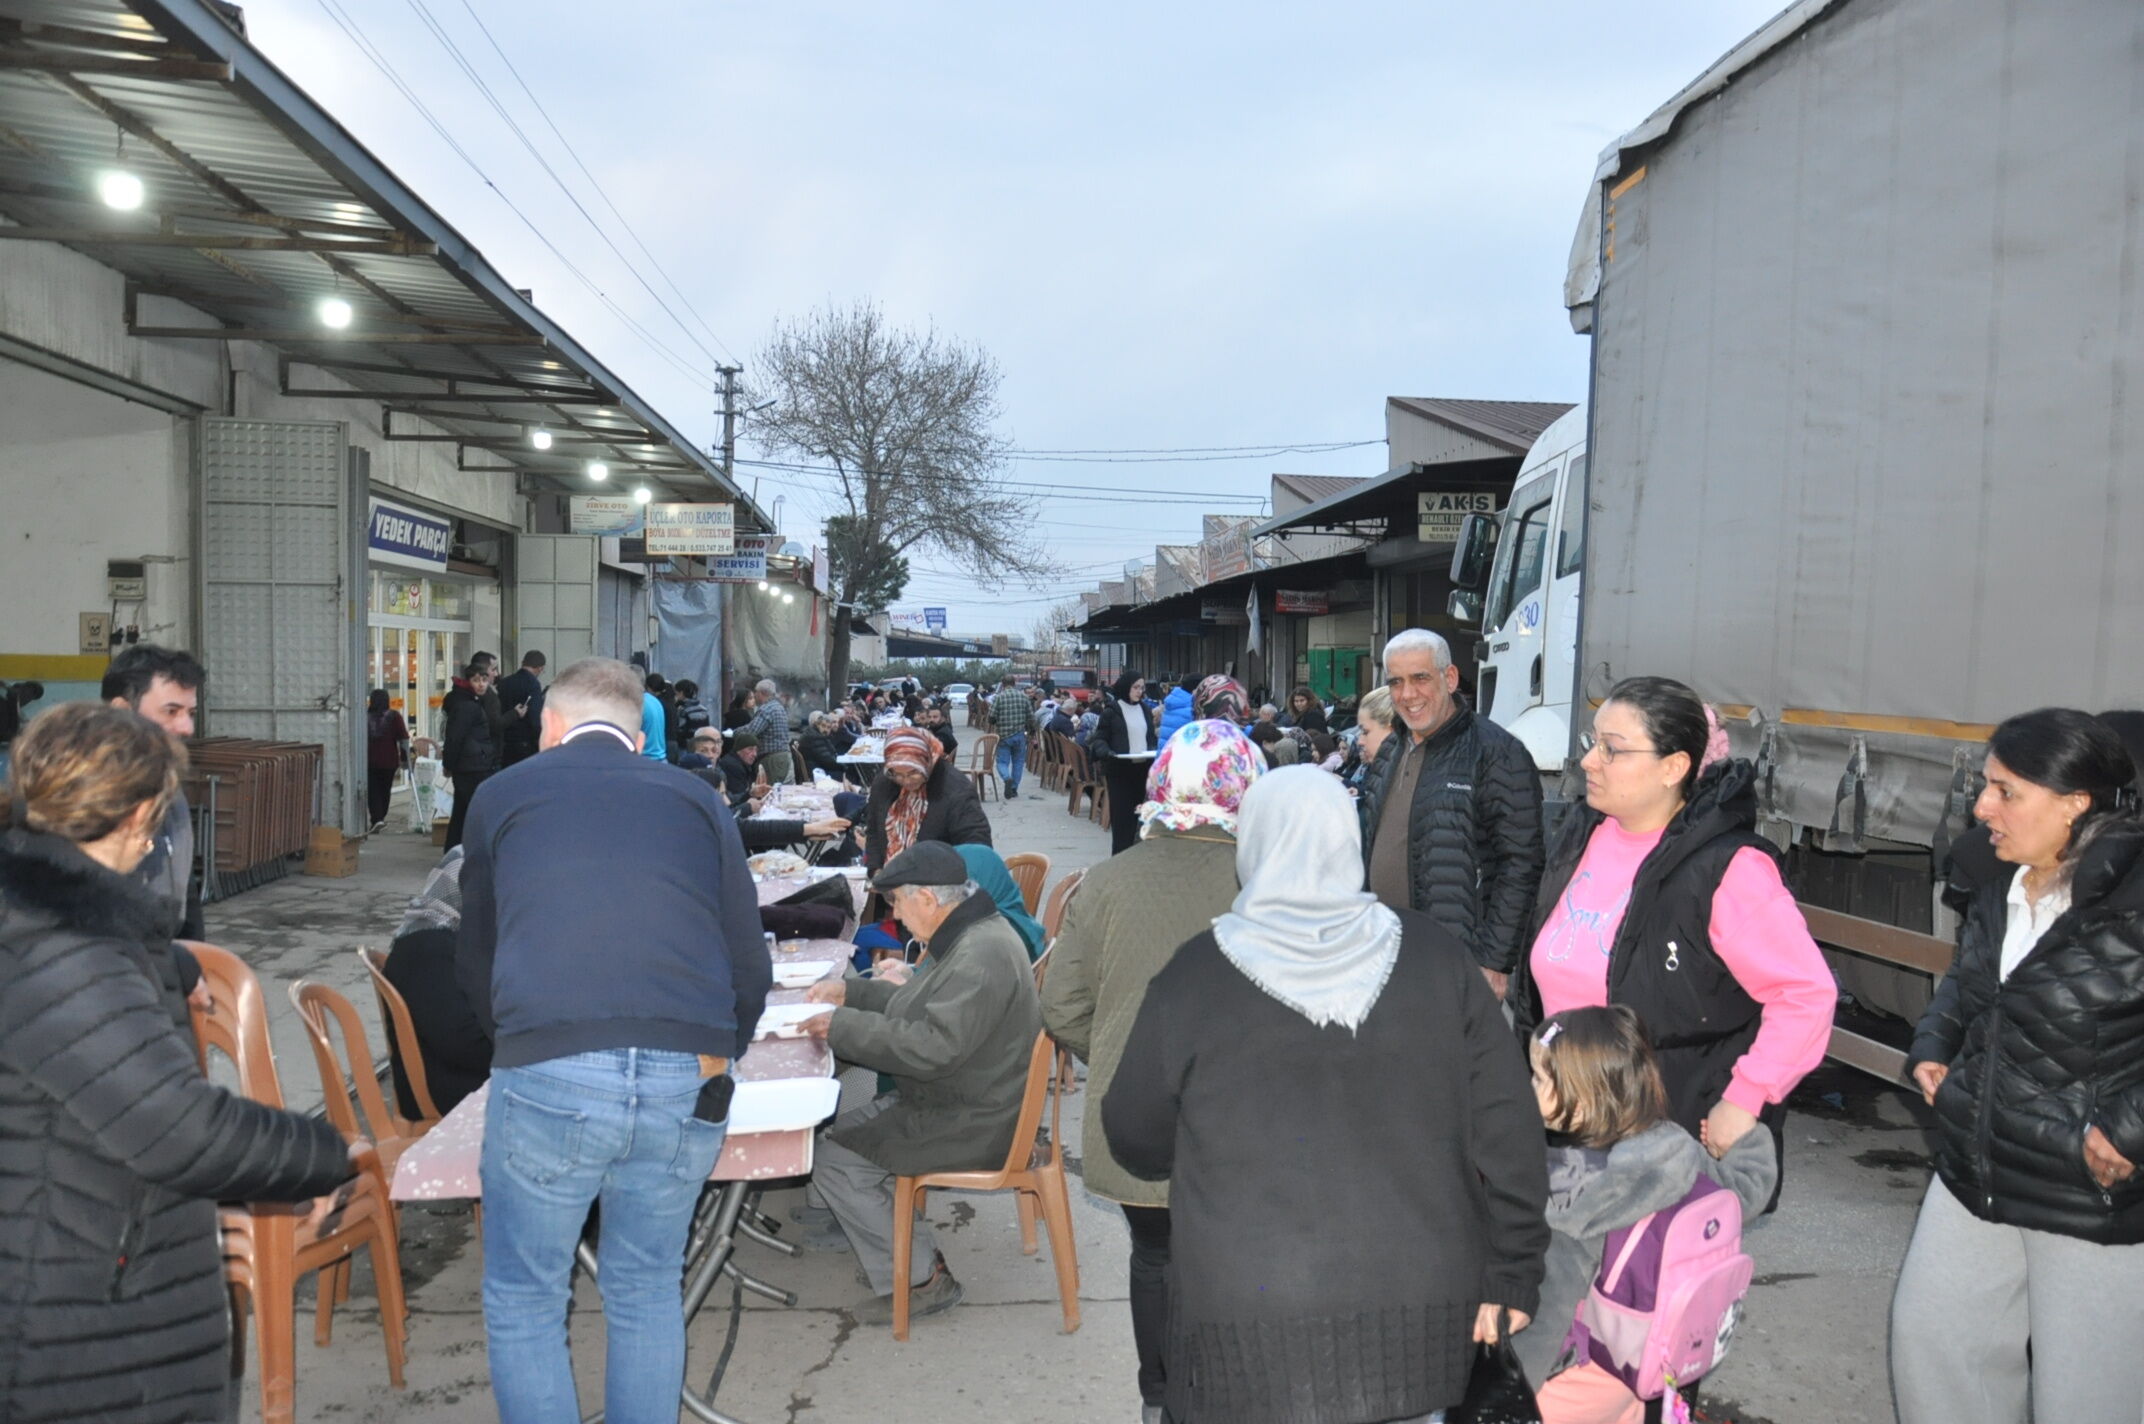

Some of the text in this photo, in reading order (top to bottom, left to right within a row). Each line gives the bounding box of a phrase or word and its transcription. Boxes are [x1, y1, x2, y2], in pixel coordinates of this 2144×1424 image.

[677, 511, 694, 525] OTO
[695, 511, 733, 525] KAPORTA
[375, 512, 448, 558] YEDEK PARÇA
[743, 539, 765, 549] OTO
[737, 551, 765, 559] BAKIM
[716, 558, 761, 569] SERVİSİ
